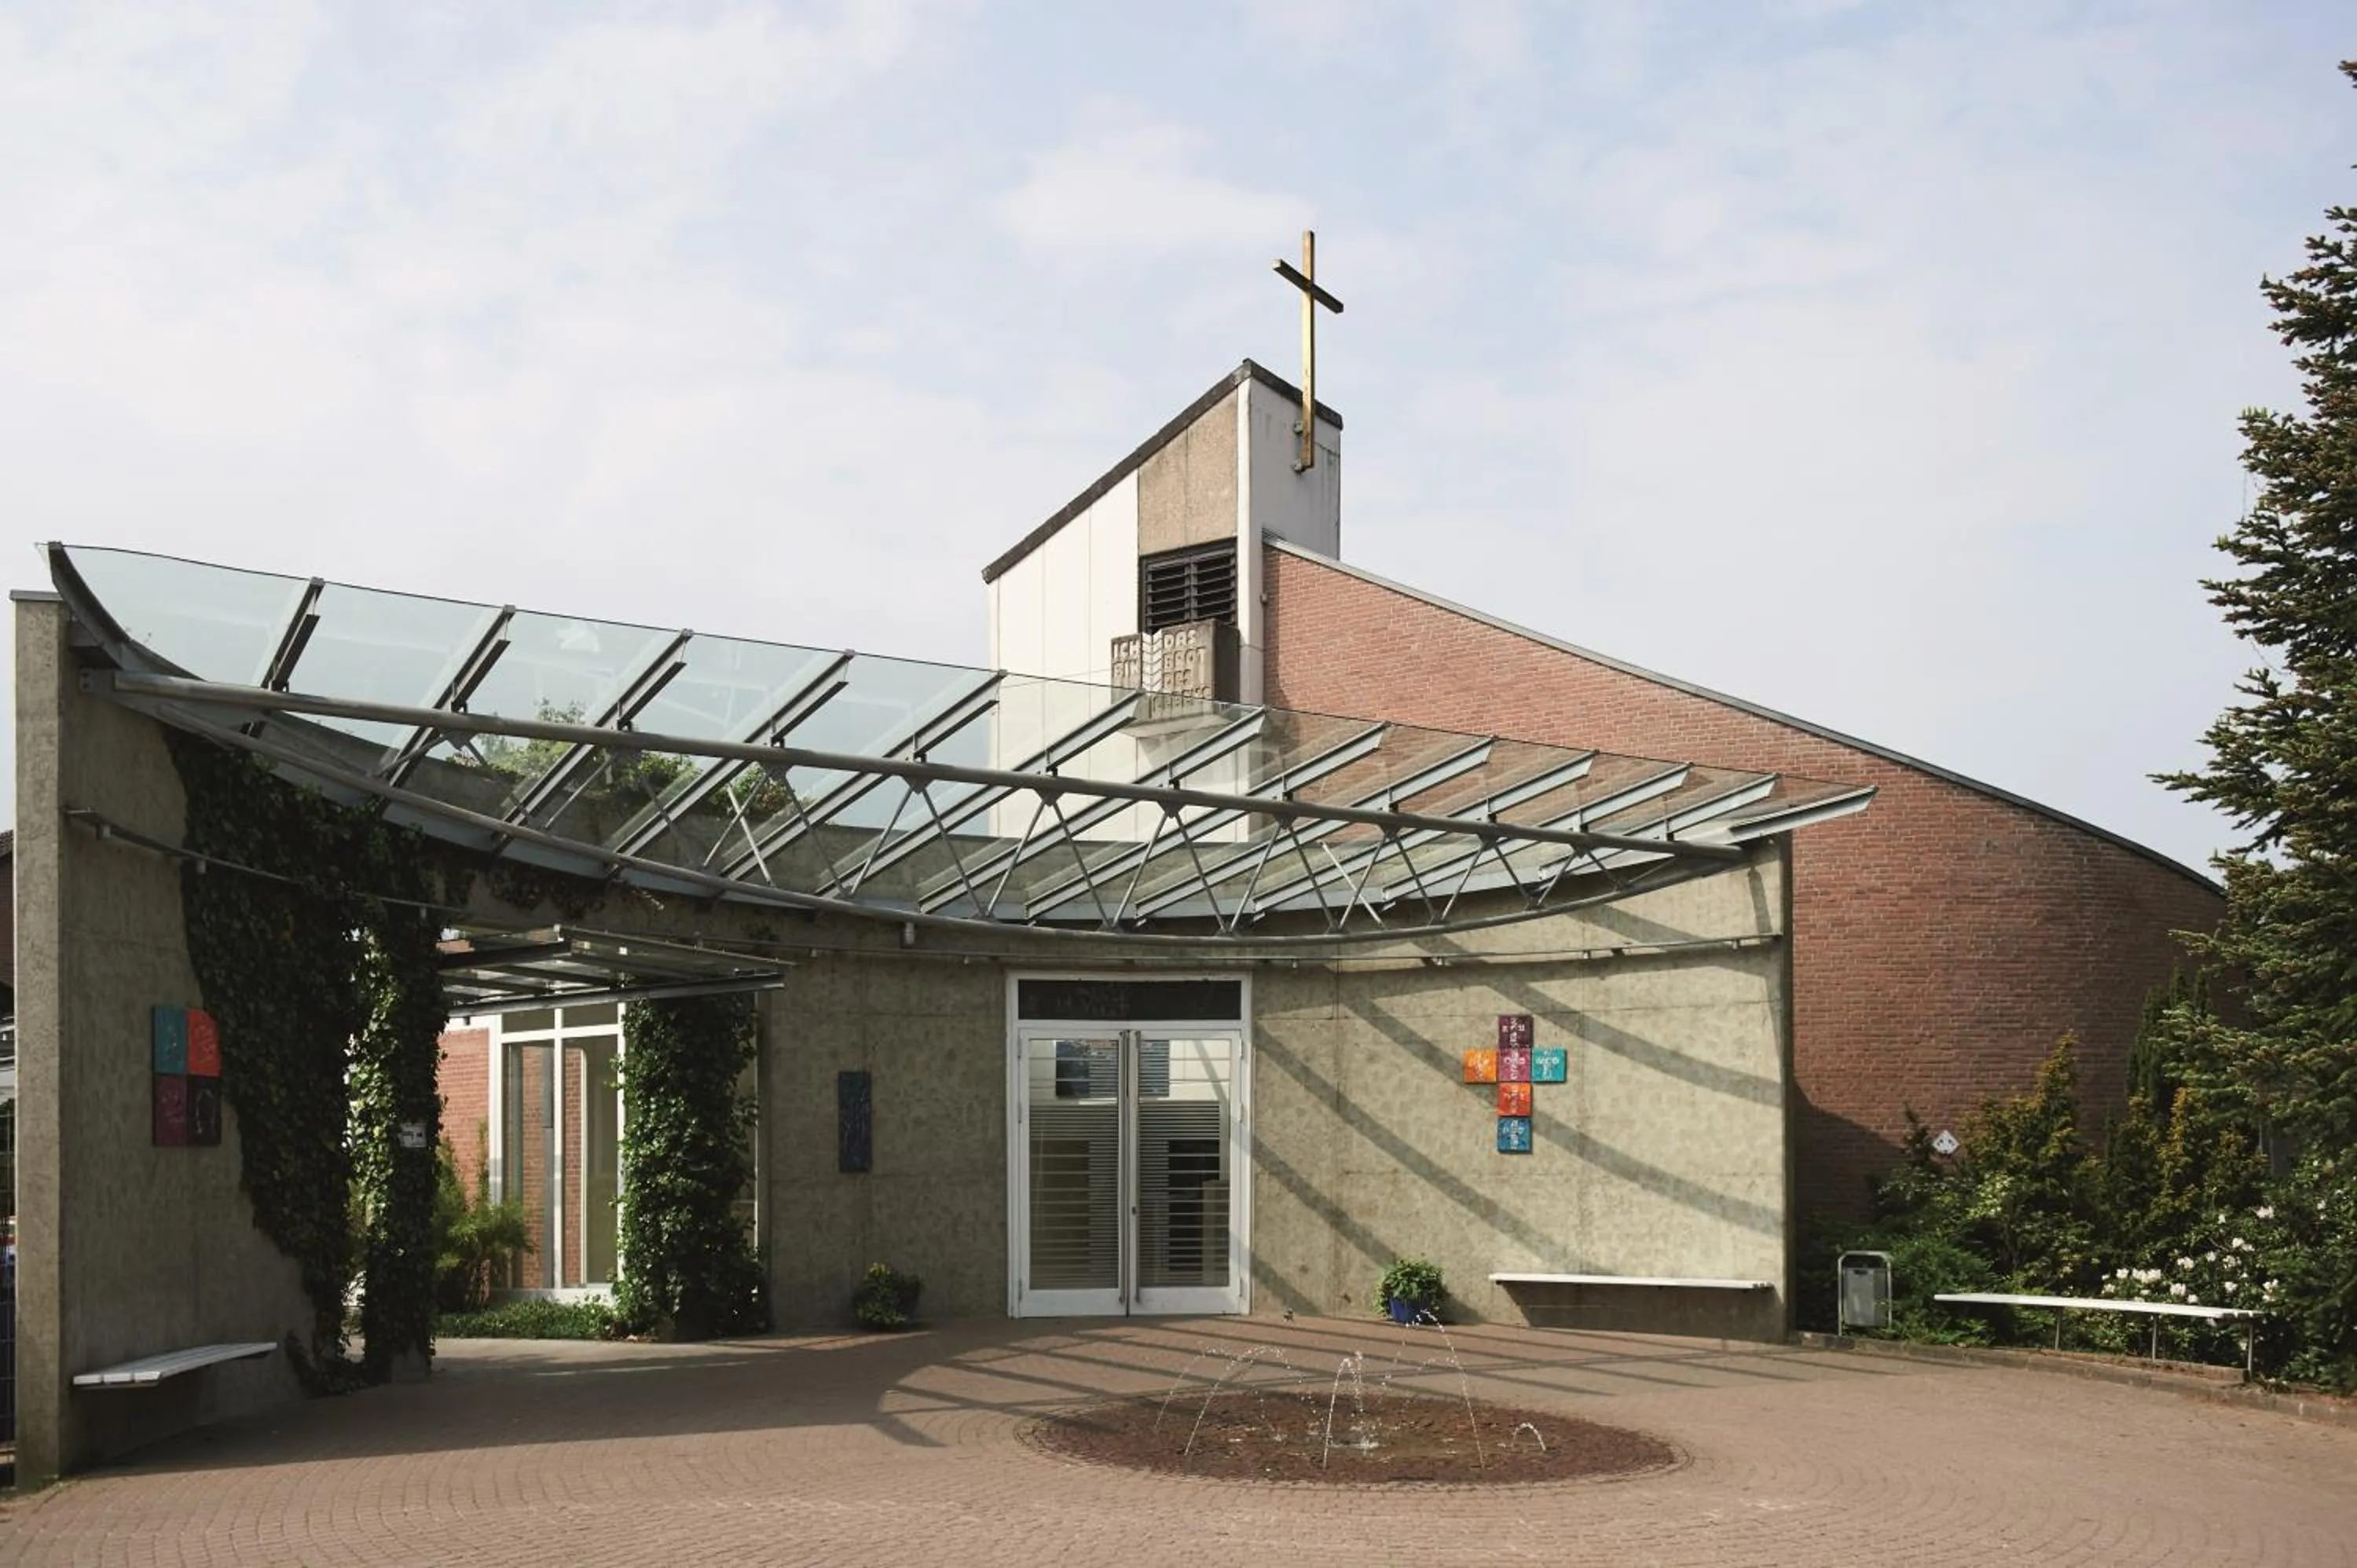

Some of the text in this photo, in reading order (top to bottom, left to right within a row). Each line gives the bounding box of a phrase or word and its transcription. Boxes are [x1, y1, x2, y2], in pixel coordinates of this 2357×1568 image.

[1113, 639, 1141, 659] ICH
[1163, 629, 1197, 650] DAS
[1163, 647, 1207, 671] BROT
